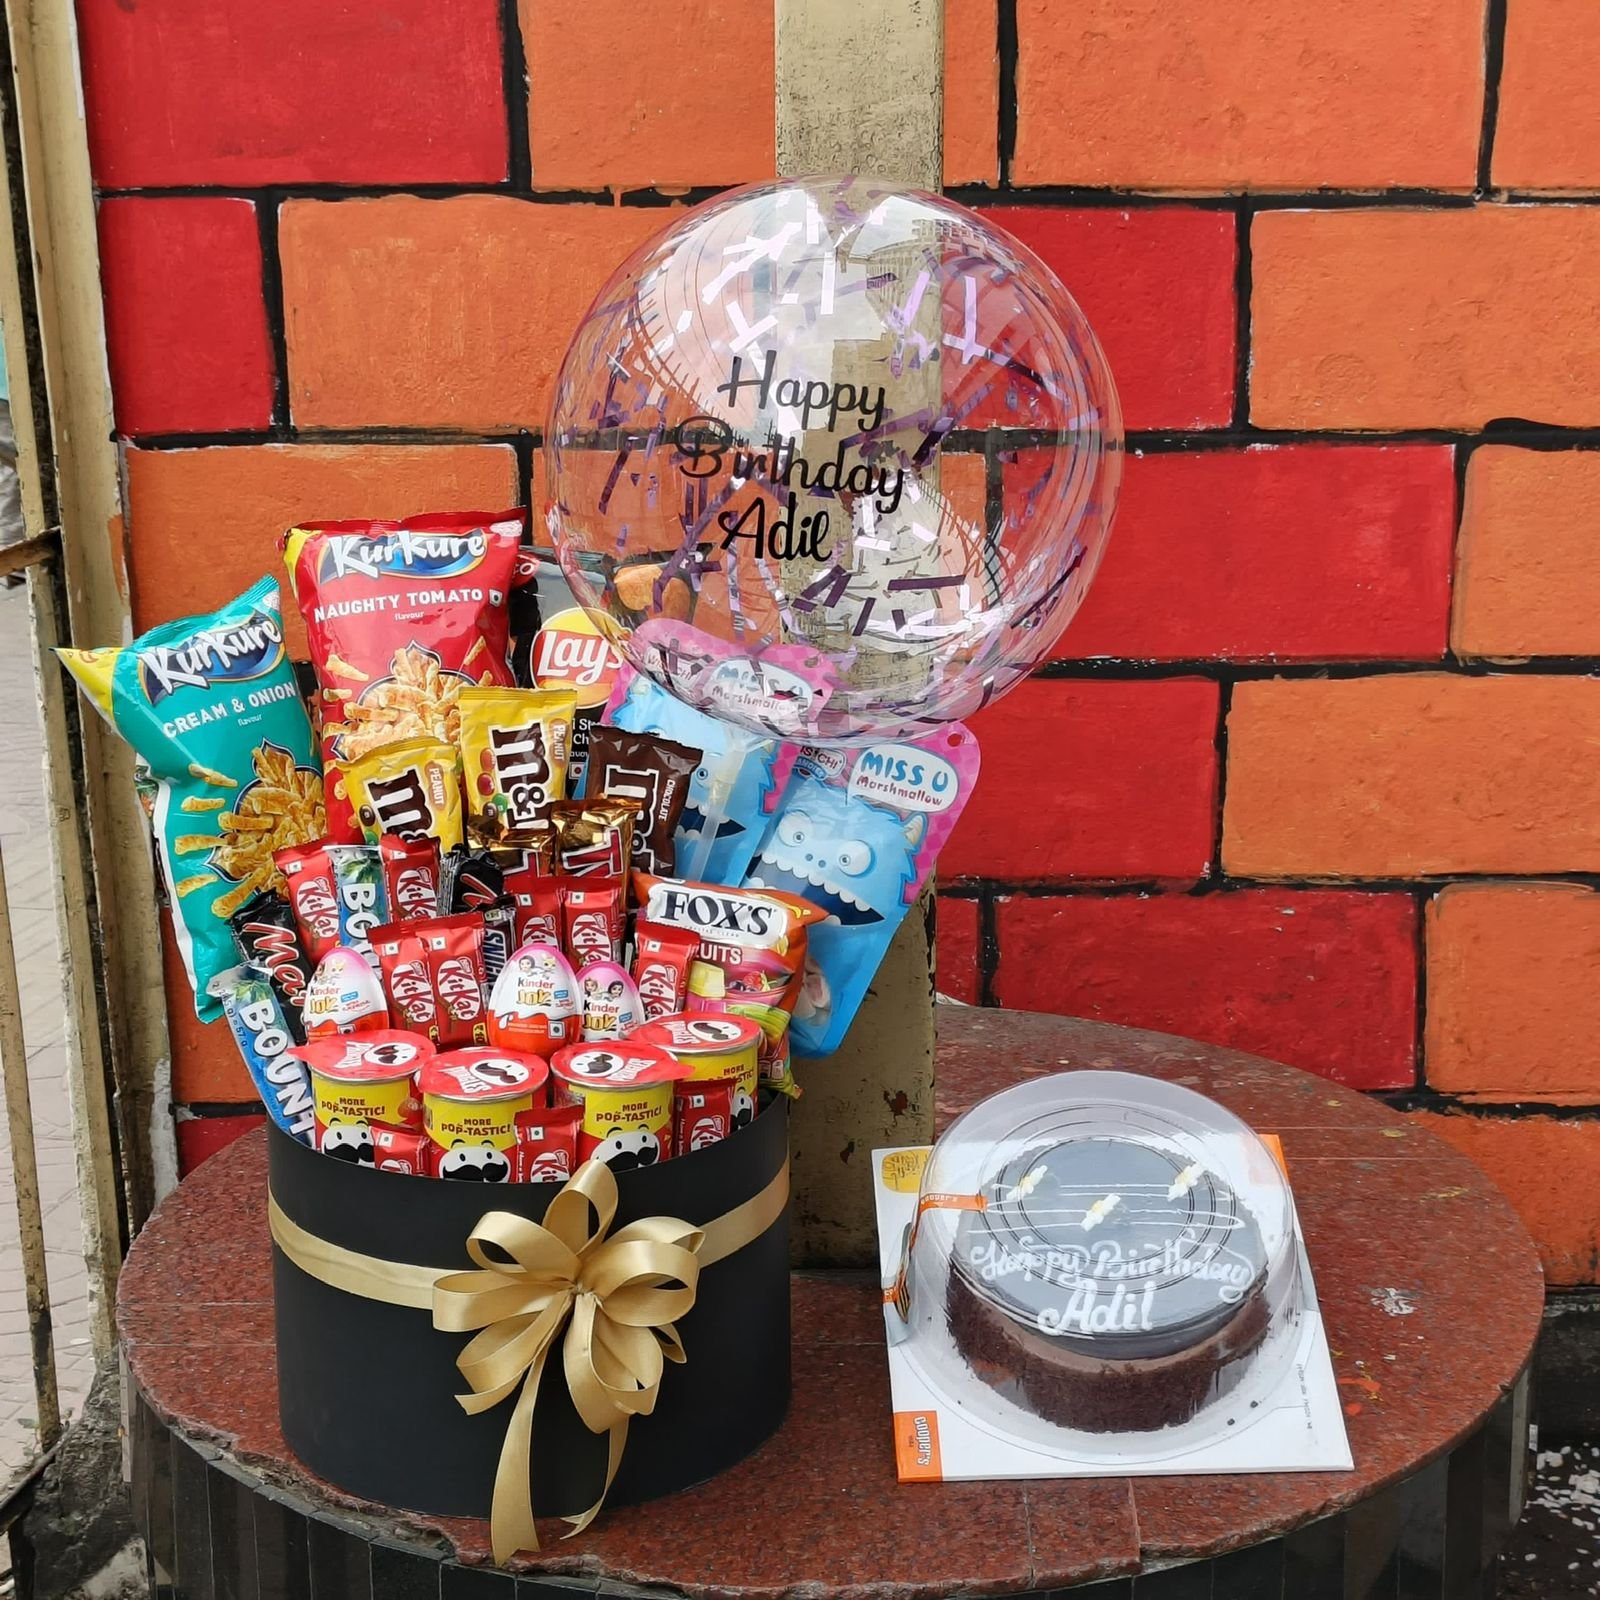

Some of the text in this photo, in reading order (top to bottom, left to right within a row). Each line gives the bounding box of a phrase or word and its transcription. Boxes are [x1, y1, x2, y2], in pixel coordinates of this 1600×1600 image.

[717, 350, 885, 432] Happy
[674, 415, 904, 514] Birthday
[718, 491, 832, 562] Adil
[329, 530, 486, 579] Kurkure
[314, 589, 483, 623] NAUGHTY TOMATO
[394, 611, 425, 621] flavour
[138, 619, 282, 695] Kurkure
[162, 682, 296, 738] CREAM & ONION
[237, 713, 262, 727] flavour
[553, 724, 565, 761] PEANUT
[427, 767, 444, 805] PEANUT
[861, 751, 925, 786] MISS
[931, 770, 949, 792] U
[659, 779, 676, 822] CHOCOLATE
[856, 775, 944, 807] Marshmallow
[660, 889, 773, 936] FOX'S
[517, 977, 555, 990] Kinder
[584, 999, 620, 1013] Kinder
[724, 1064, 745, 1076] MORE
[321, 1100, 385, 1117] POP-TASTIC!
[339, 1097, 366, 1106] MORE
[596, 1106, 662, 1122] POP-TASTIC!
[622, 1102, 648, 1112] MORE
[441, 1123, 511, 1136] POP-TASTIC!
[464, 1118, 491, 1126] MORE
[971, 1228, 1254, 1304] Happy Birthday
[1037, 1280, 1157, 1336] Adil
